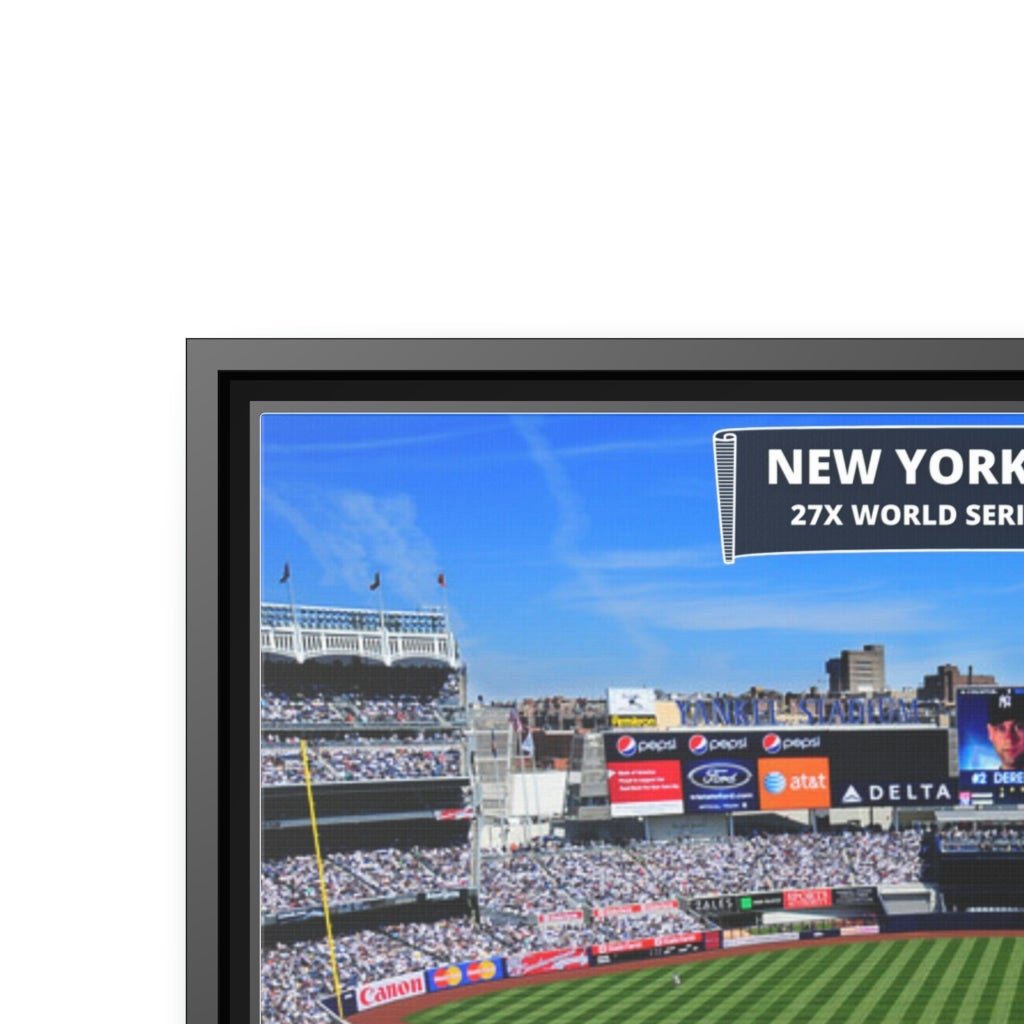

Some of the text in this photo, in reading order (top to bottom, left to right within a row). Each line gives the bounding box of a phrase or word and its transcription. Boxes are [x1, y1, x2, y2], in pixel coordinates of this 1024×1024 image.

[798, 697, 920, 726] STADIUM
[638, 738, 677, 752] pepsi
[709, 737, 748, 751] pepsi
[782, 736, 821, 750] pepsi
[702, 768, 738, 785] Ford
[789, 773, 827, 790] at&t
[971, 771, 988, 784] #2
[869, 784, 951, 801] DELTA
[359, 977, 423, 1006] Canon
